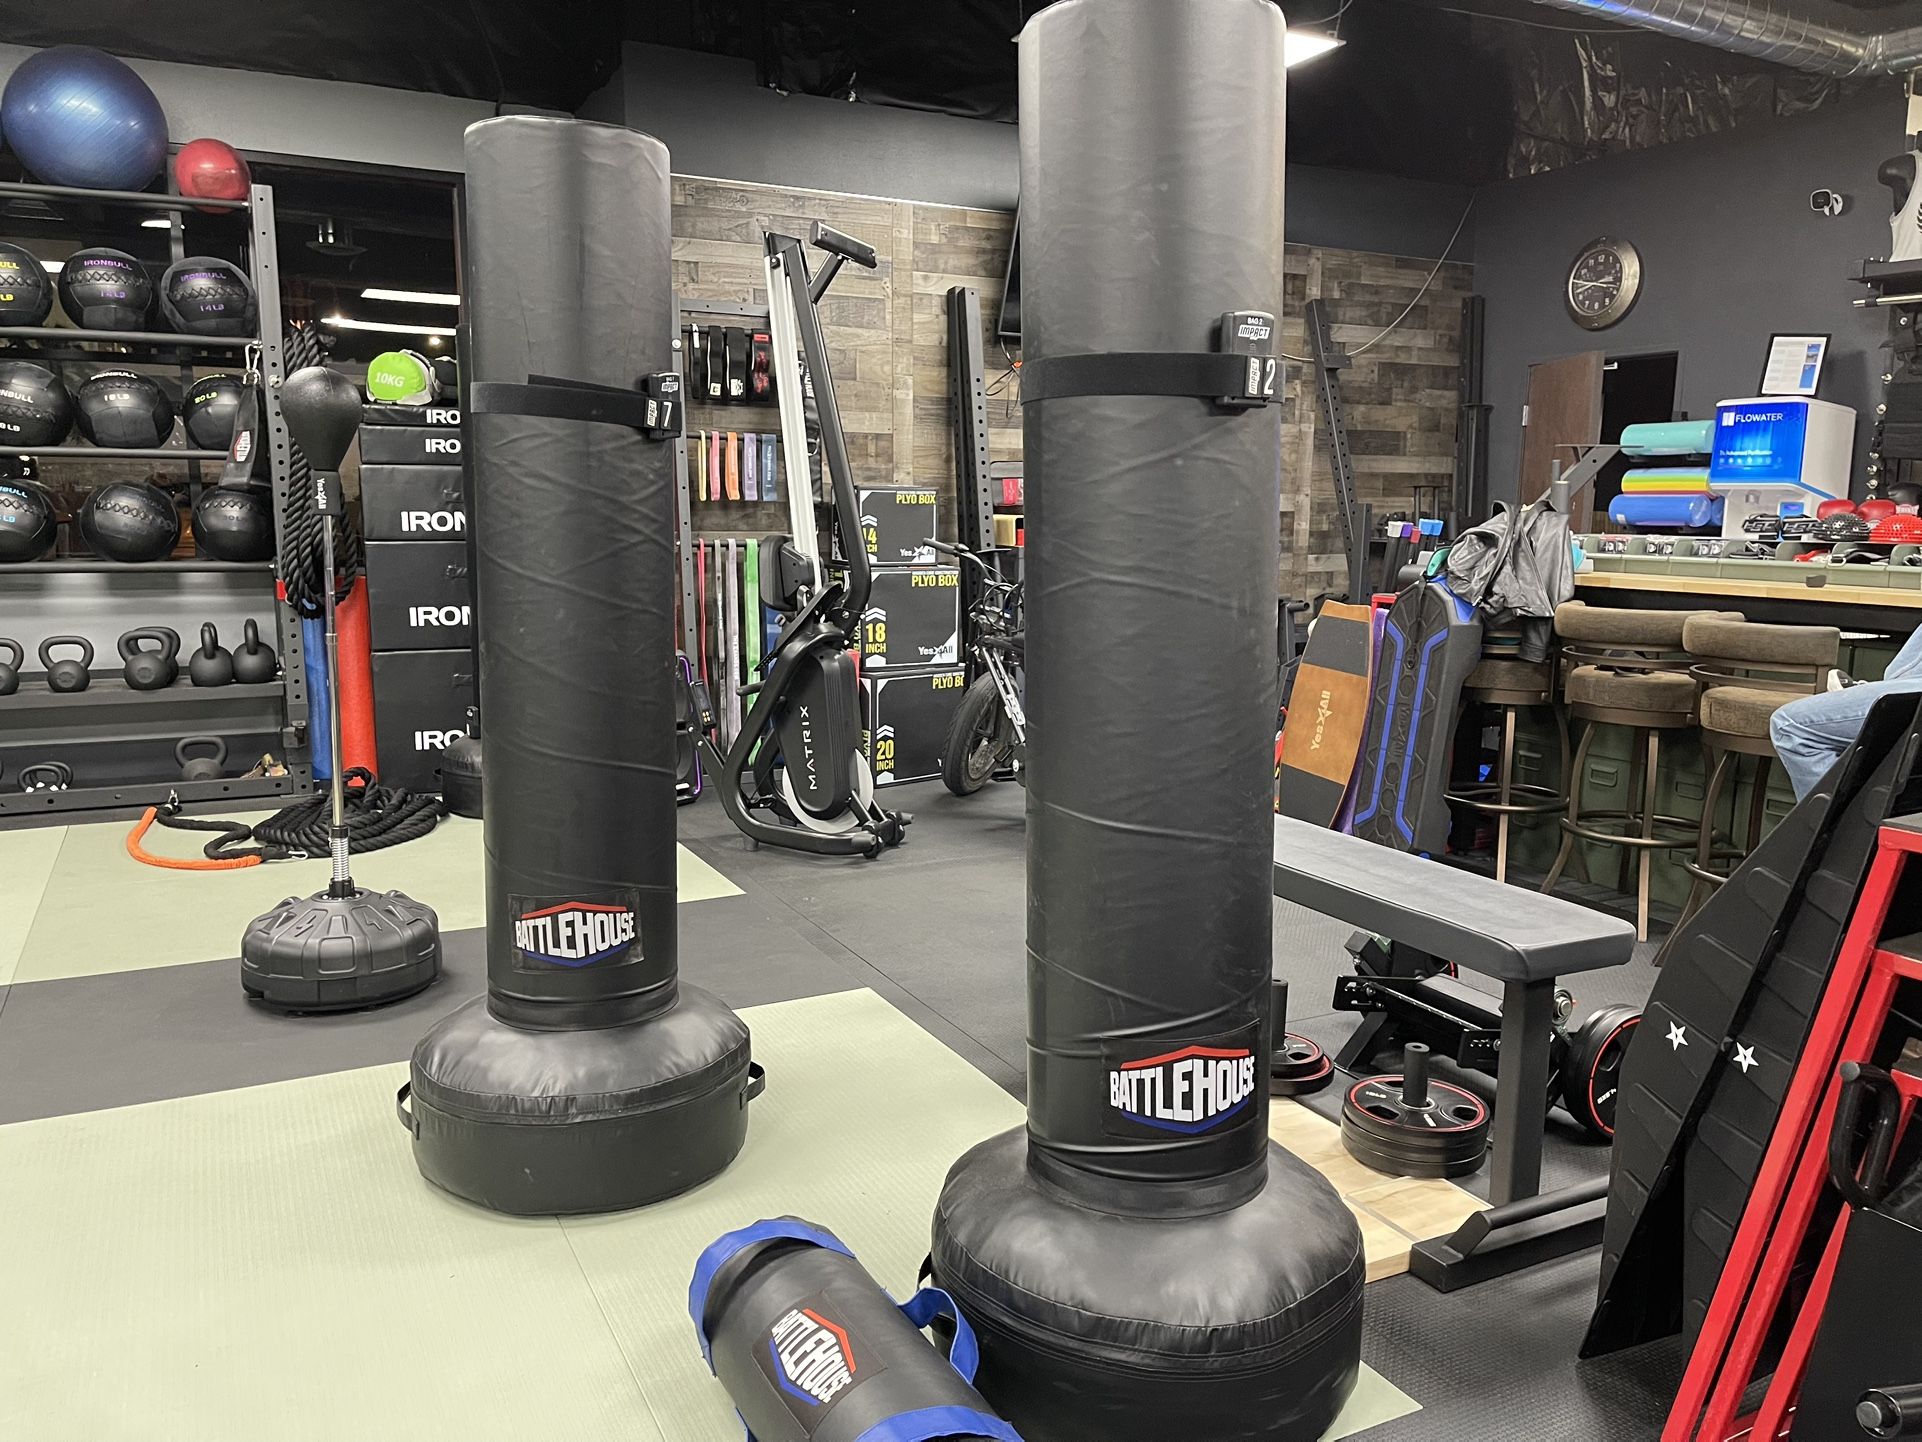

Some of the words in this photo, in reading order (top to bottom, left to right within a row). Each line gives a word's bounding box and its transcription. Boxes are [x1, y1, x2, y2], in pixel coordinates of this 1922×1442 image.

[84, 260, 133, 270] IRONBULL
[181, 272, 227, 282] IRONBULL
[1240, 326, 1268, 338] IMPACT
[375, 371, 405, 388] 10KG
[1263, 358, 1276, 395] 2
[663, 401, 673, 427] 7
[1735, 412, 1784, 423] FLOWATER
[896, 494, 918, 505] PLYO
[918, 494, 937, 505] BOX
[911, 575, 936, 588] PLYO
[938, 574, 959, 587] BOX
[865, 623, 886, 643] 18
[865, 643, 887, 654] INCH
[932, 677, 954, 690] PLYO
[800, 705, 818, 790] MATRIX
[876, 739, 895, 760] 20
[876, 759, 895, 771] INCH
[515, 911, 636, 959] BATTLEHOUSE
[1109, 1055, 1256, 1122] BATTLEHOUSE
[771, 1308, 853, 1404] BATTLEHOUSE
